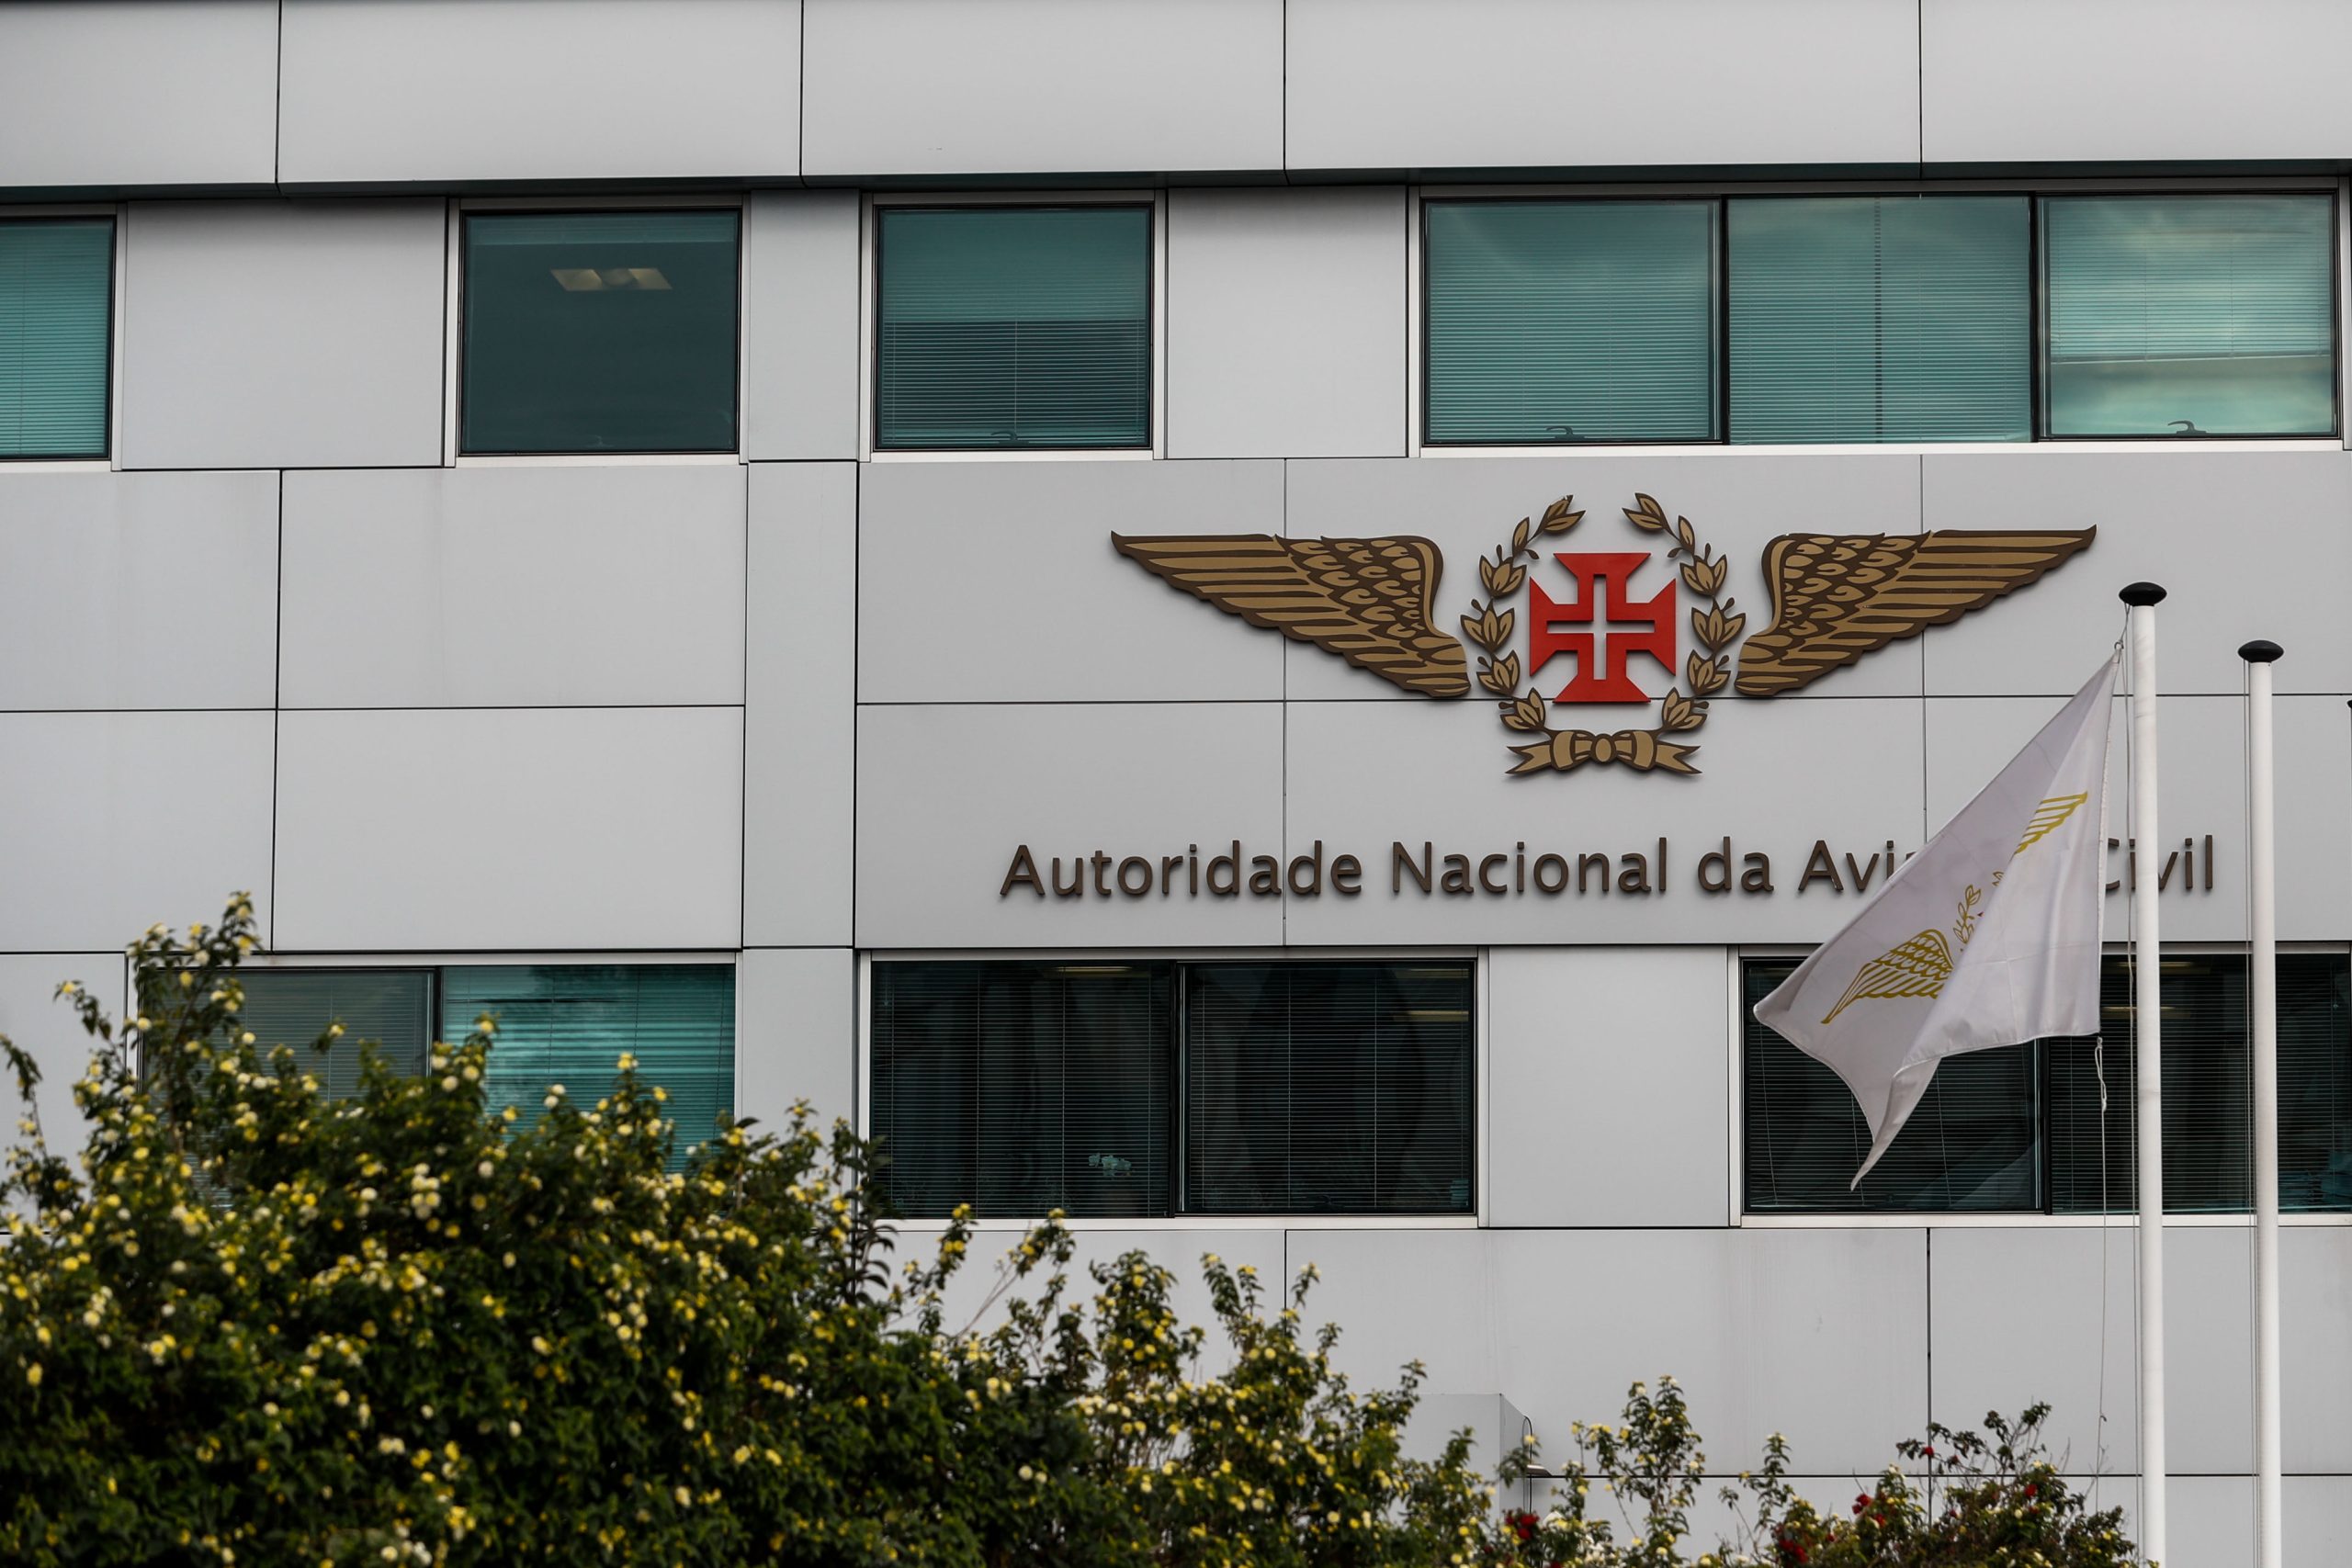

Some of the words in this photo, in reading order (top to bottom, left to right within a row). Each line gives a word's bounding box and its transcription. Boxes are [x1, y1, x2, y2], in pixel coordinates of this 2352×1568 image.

[999, 840, 1363, 901] Autoridade
[1392, 837, 1668, 898] Nacional
[1697, 836, 1775, 897] da
[1797, 840, 1917, 894] Avi
